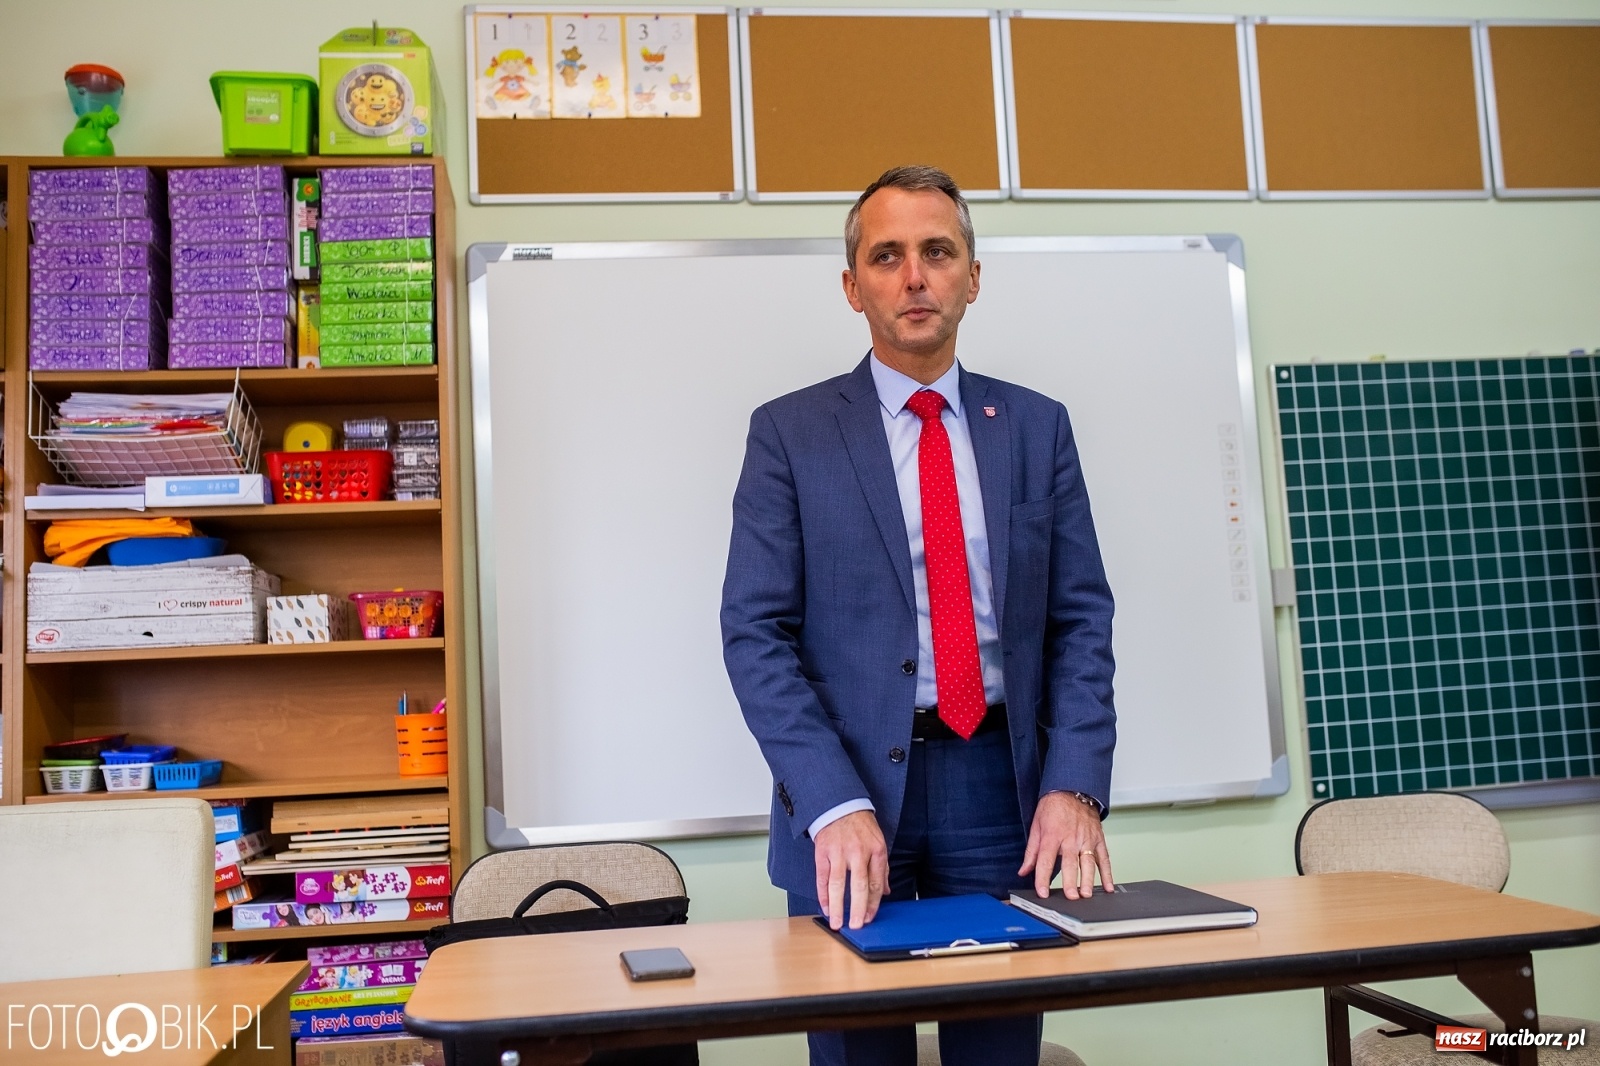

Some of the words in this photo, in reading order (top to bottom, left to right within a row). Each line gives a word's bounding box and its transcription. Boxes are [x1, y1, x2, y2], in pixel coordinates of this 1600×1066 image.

[492, 24, 498, 40] 1
[565, 24, 576, 40] 2
[638, 24, 649, 40] 3
[180, 601, 207, 609] crispy
[209, 598, 243, 607] natural
[381, 976, 406, 984] MEMO
[311, 1013, 350, 1033] język
